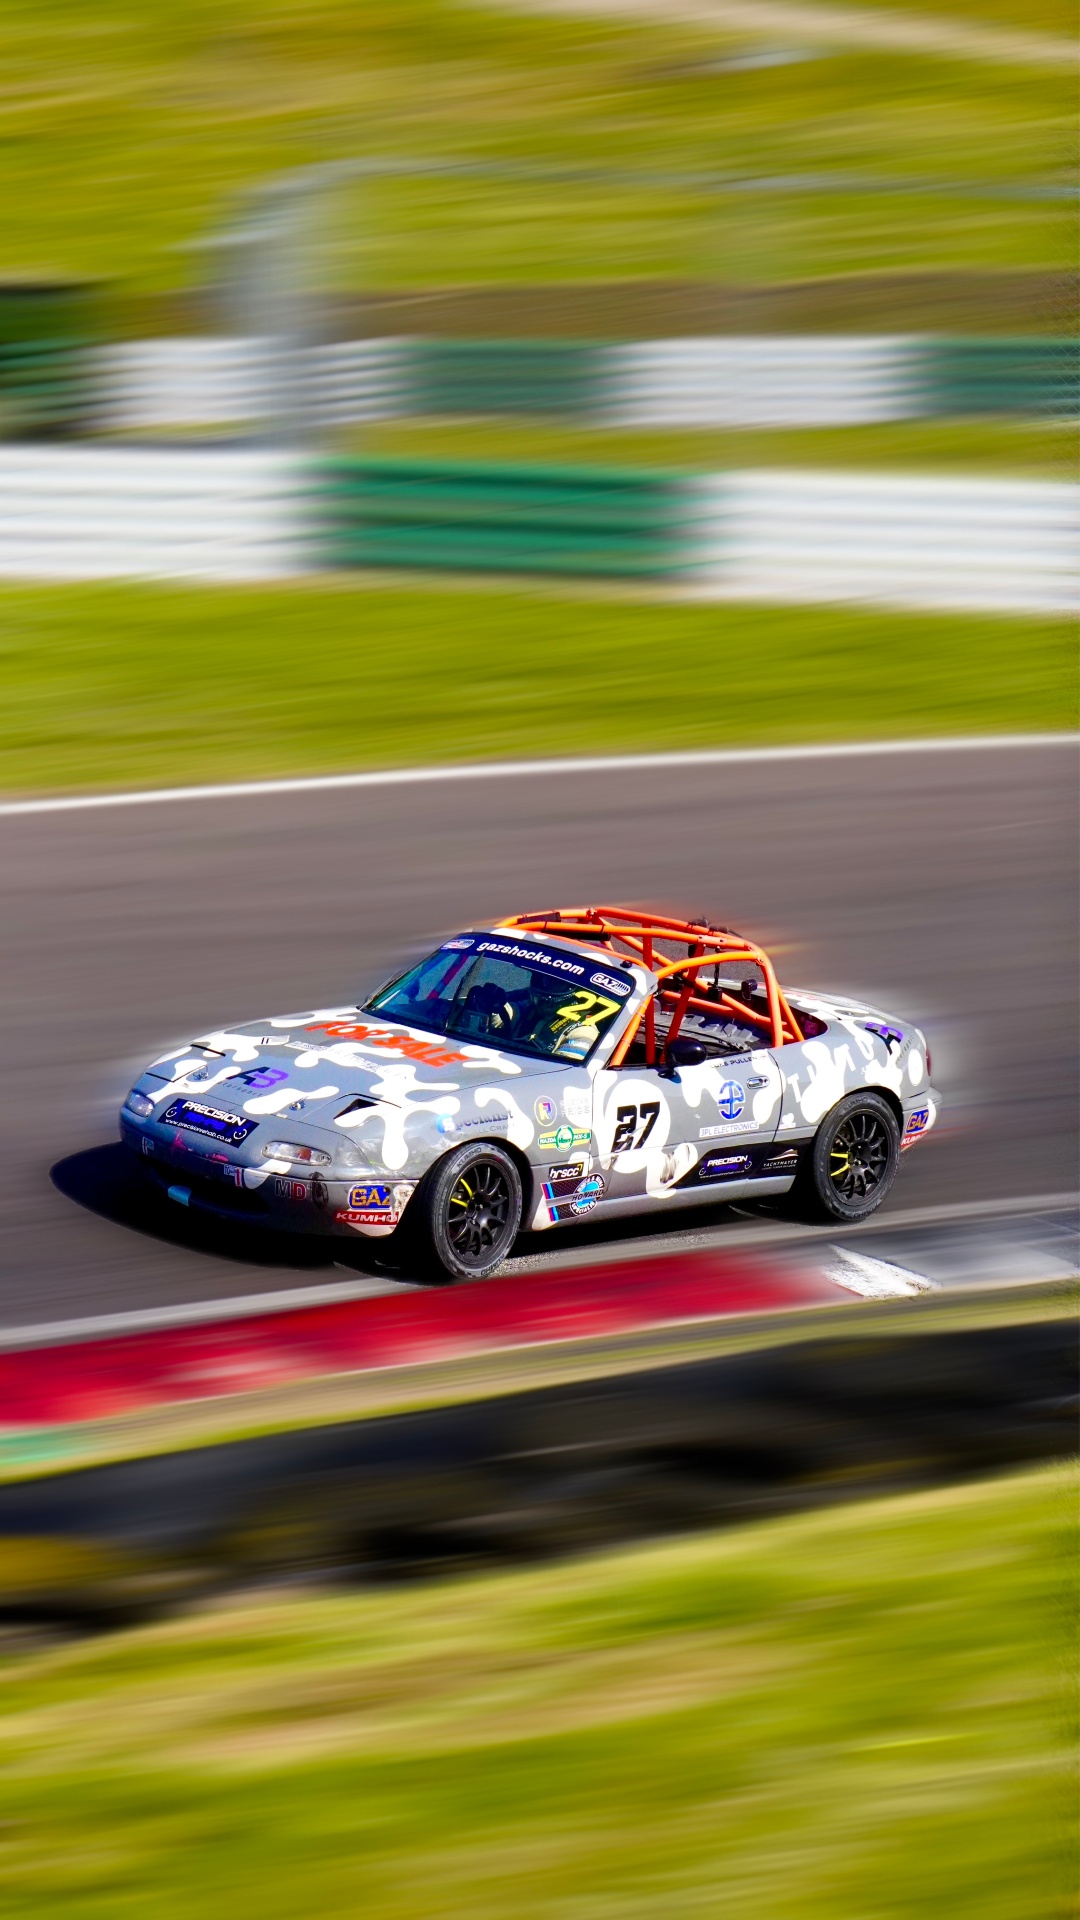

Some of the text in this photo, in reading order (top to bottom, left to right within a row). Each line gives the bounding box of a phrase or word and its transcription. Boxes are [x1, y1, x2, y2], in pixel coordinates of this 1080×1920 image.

[476, 941, 585, 976] gazshocks.com
[556, 990, 621, 1026] 27
[372, 1035, 470, 1068] SALE
[182, 1101, 247, 1127] PRECISION
[611, 1101, 660, 1154] 27
[713, 1121, 759, 1134] ELECTRONICS
[707, 1155, 748, 1167] PRECISION
